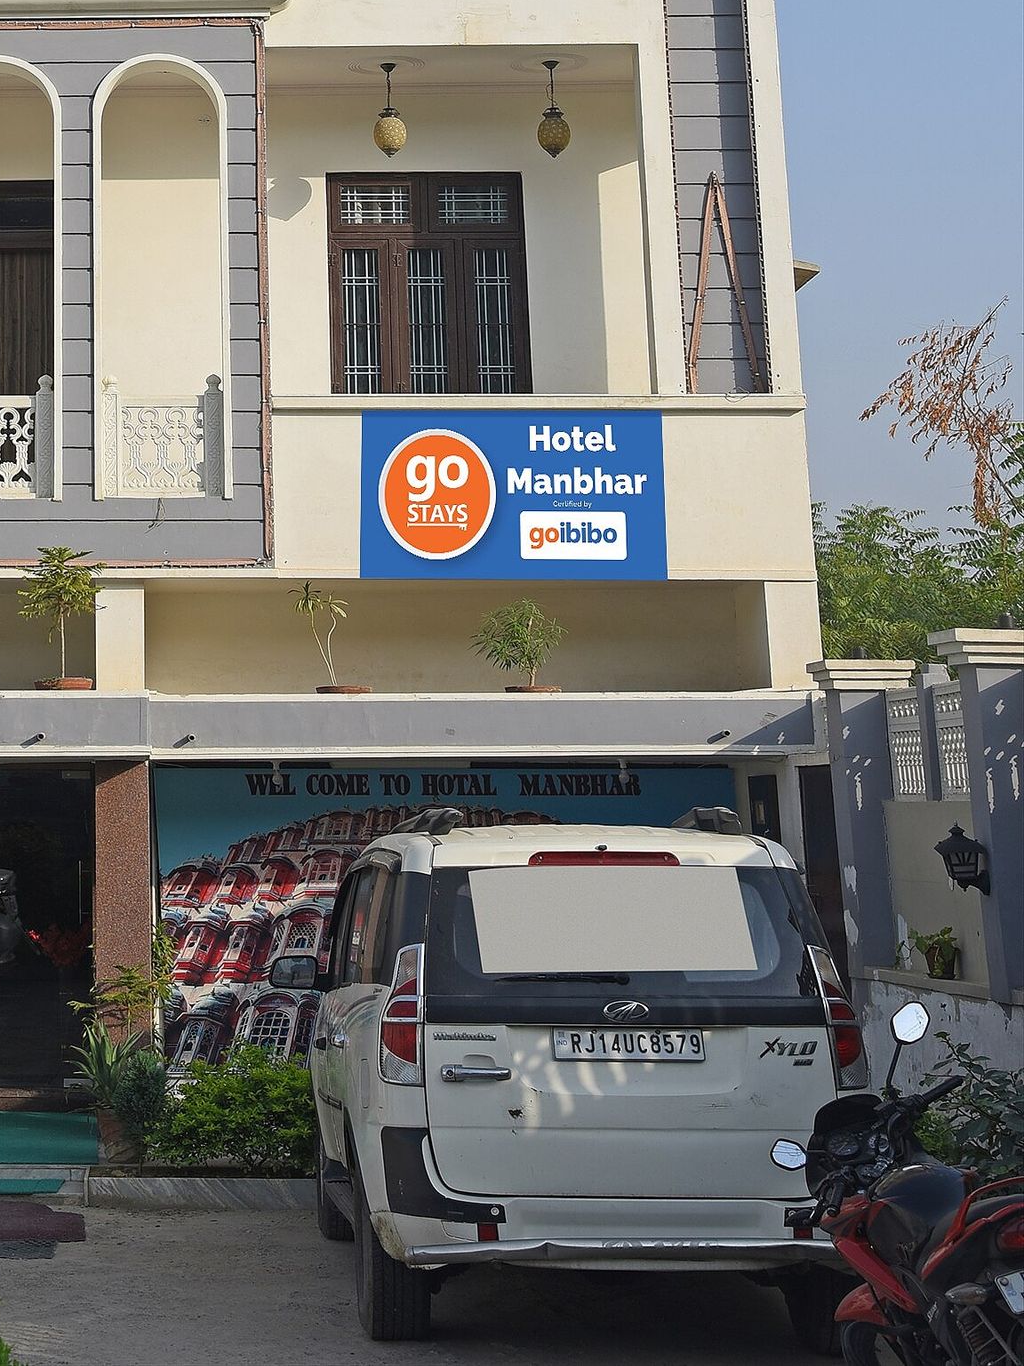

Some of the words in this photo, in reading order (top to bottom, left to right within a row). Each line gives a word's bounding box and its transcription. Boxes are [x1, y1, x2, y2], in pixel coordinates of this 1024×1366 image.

[528, 424, 617, 452] Hotel
[406, 455, 469, 502] go
[507, 466, 648, 495] Manbhar
[407, 503, 468, 523] STAYS
[552, 500, 582, 508] Certified
[583, 500, 592, 509] by
[529, 522, 618, 549] goibibo
[245, 773, 297, 796] WEL
[305, 773, 370, 796] COME
[380, 773, 411, 796] TO
[421, 773, 497, 796] HOTAL
[517, 773, 642, 796] MANBHAR
[571, 1033, 702, 1054] RJ14UC8579
[759, 1035, 818, 1059] XYLO
